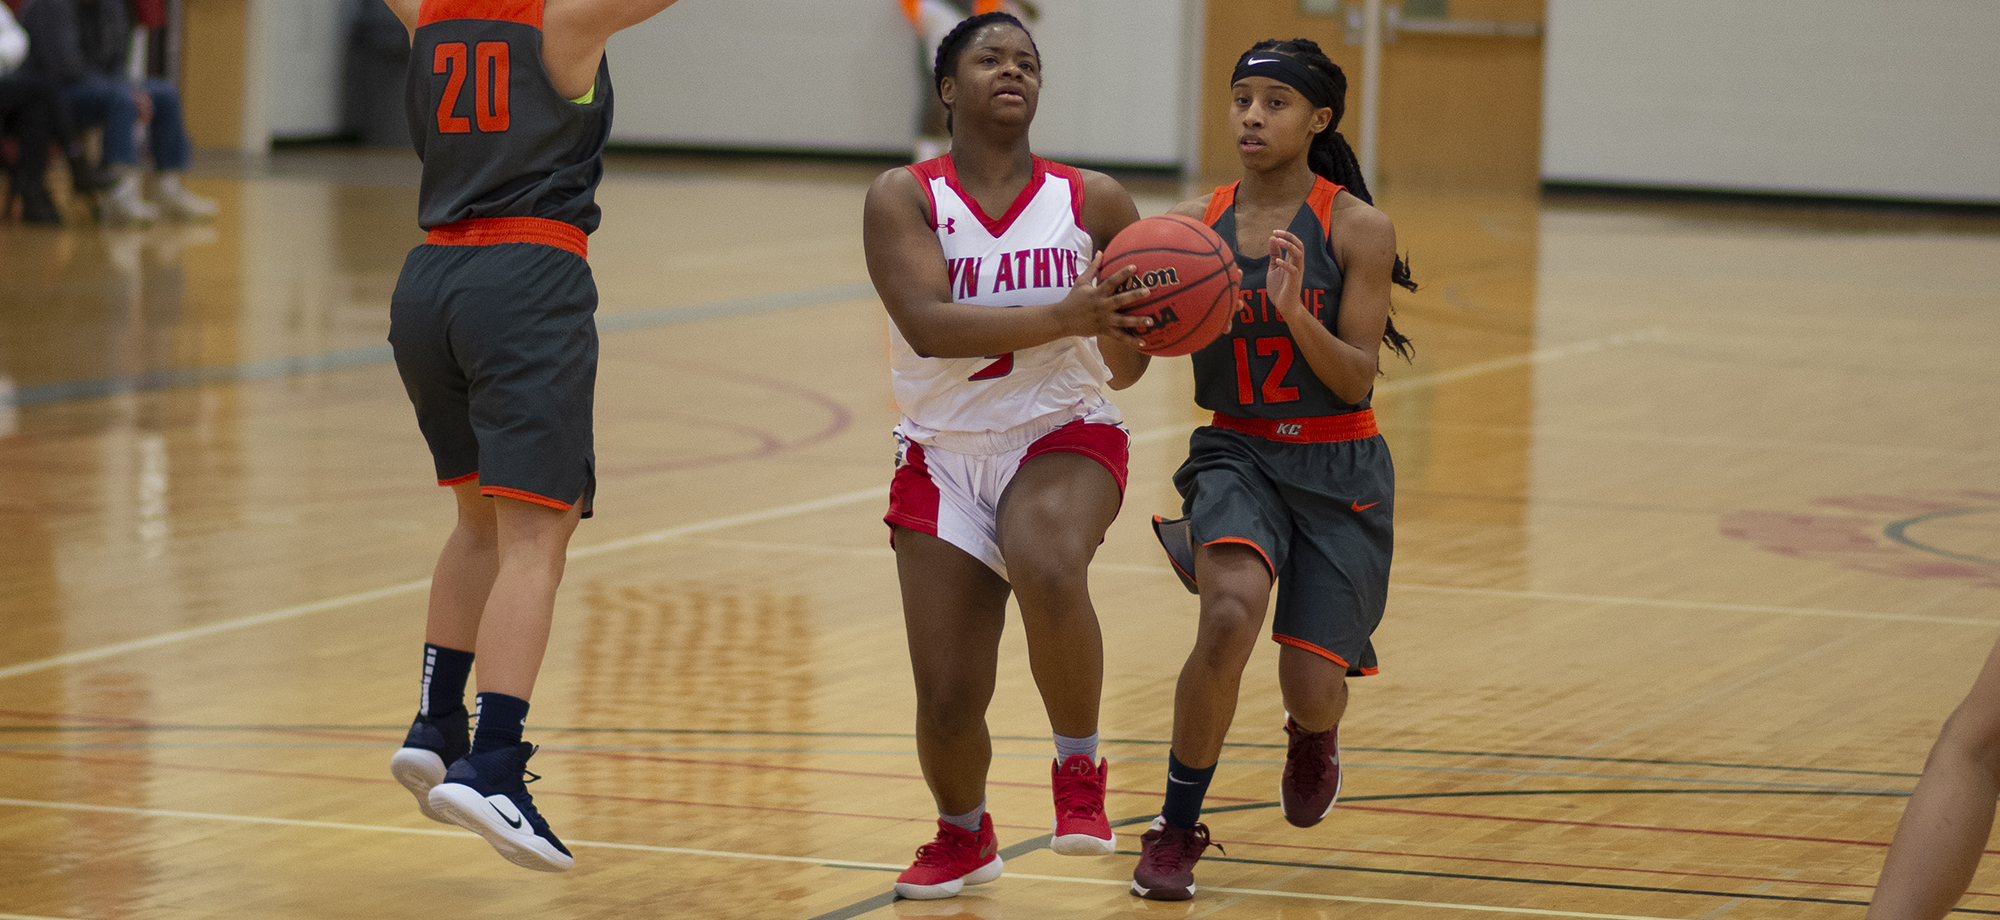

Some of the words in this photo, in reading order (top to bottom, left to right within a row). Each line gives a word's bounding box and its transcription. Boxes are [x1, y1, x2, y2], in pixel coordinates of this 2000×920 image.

[432, 41, 510, 134] 20
[945, 256, 983, 300] YN
[992, 247, 1079, 294] ATHYN
[1115, 265, 1180, 295] son
[1233, 336, 1300, 405] 12
[1276, 422, 1304, 436] KC
